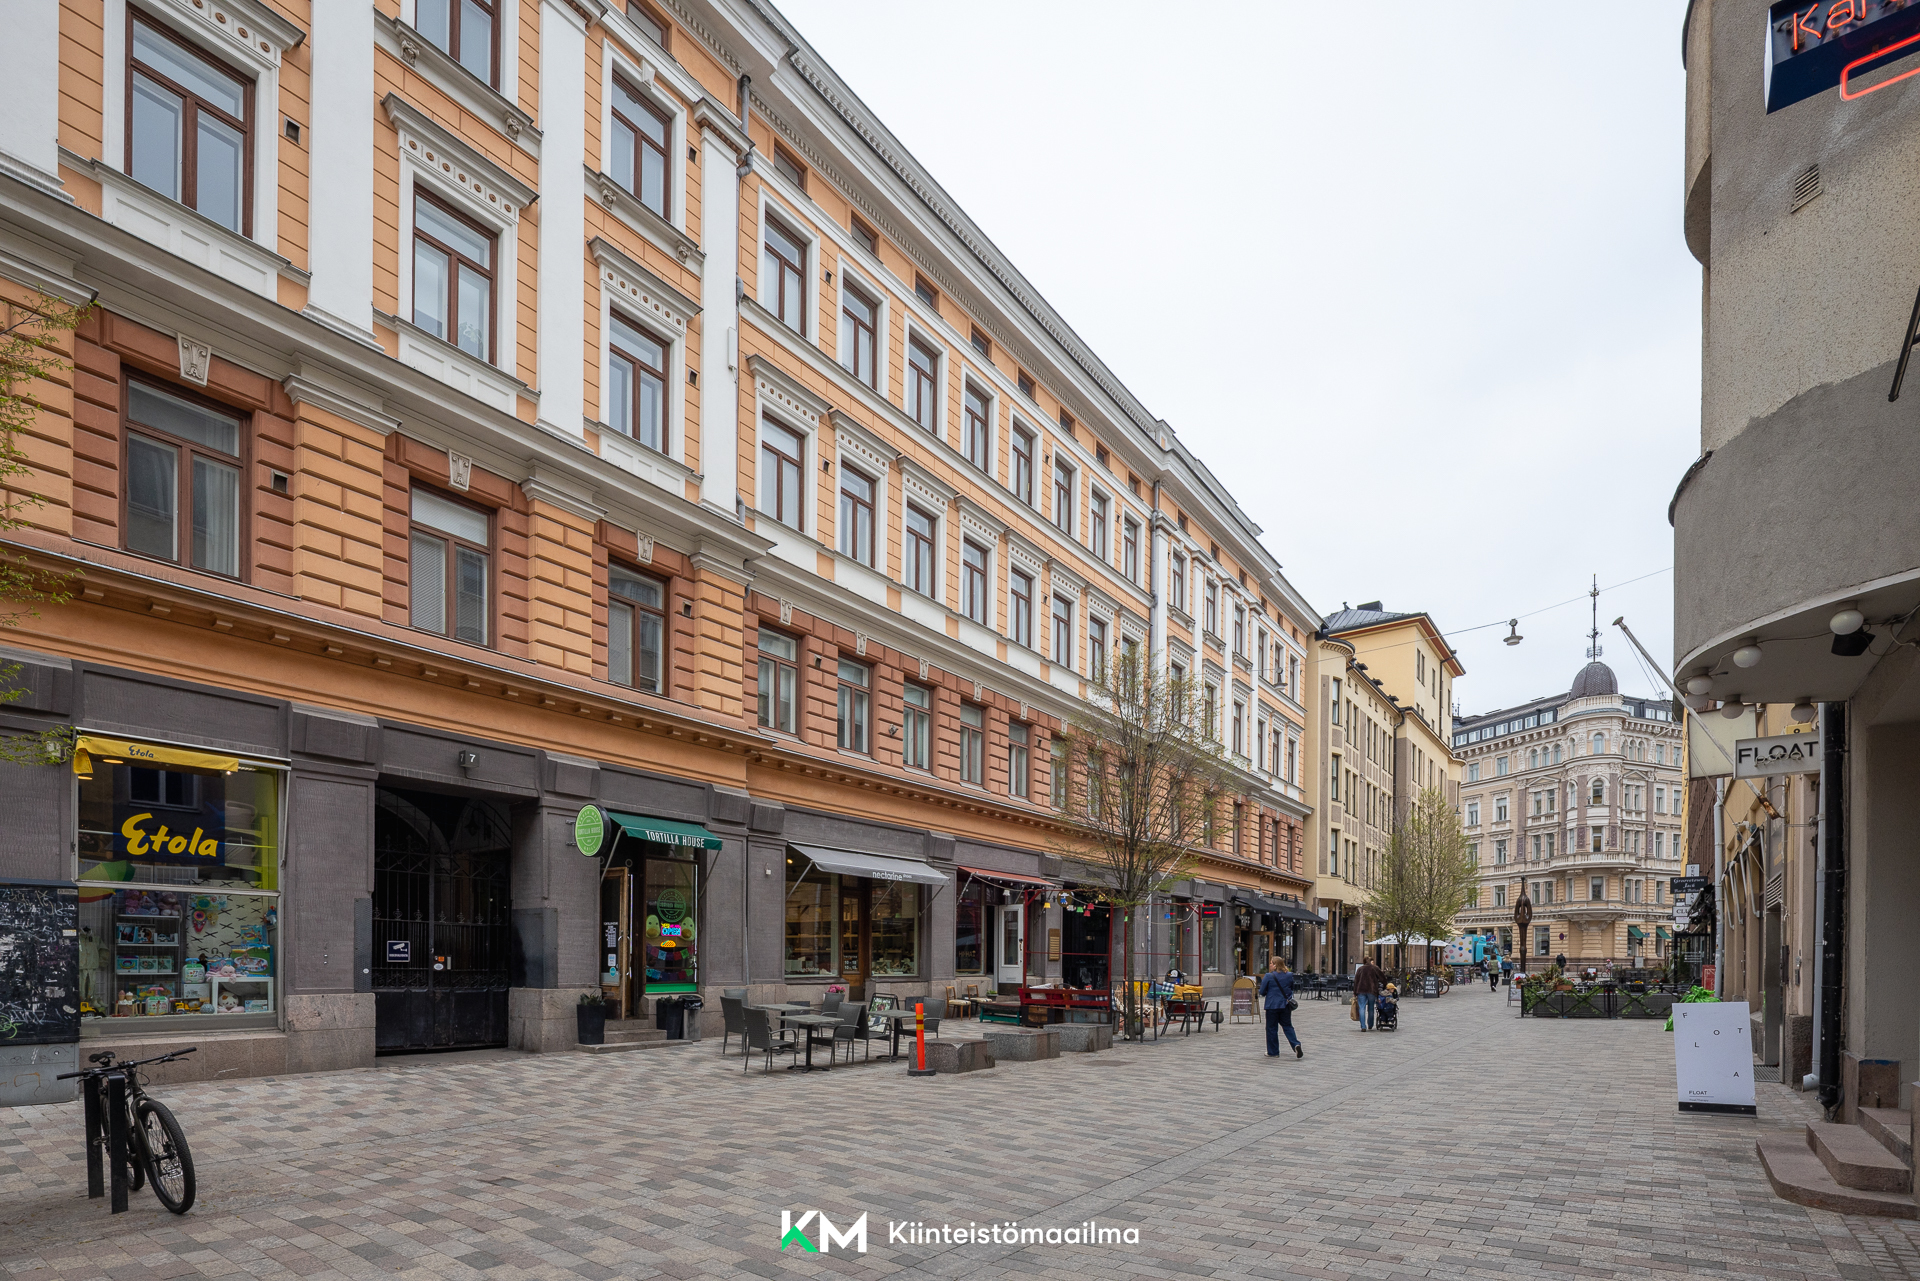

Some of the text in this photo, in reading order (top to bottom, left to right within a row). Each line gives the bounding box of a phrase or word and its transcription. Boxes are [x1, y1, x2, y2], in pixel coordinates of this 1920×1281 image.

[128, 745, 154, 759] Etola
[1738, 741, 1819, 764] FLOAT
[121, 813, 219, 857] Etola
[645, 830, 705, 848] TORTILLA HOUSE
[872, 871, 903, 881] nectarine
[662, 928, 681, 936] OPEN
